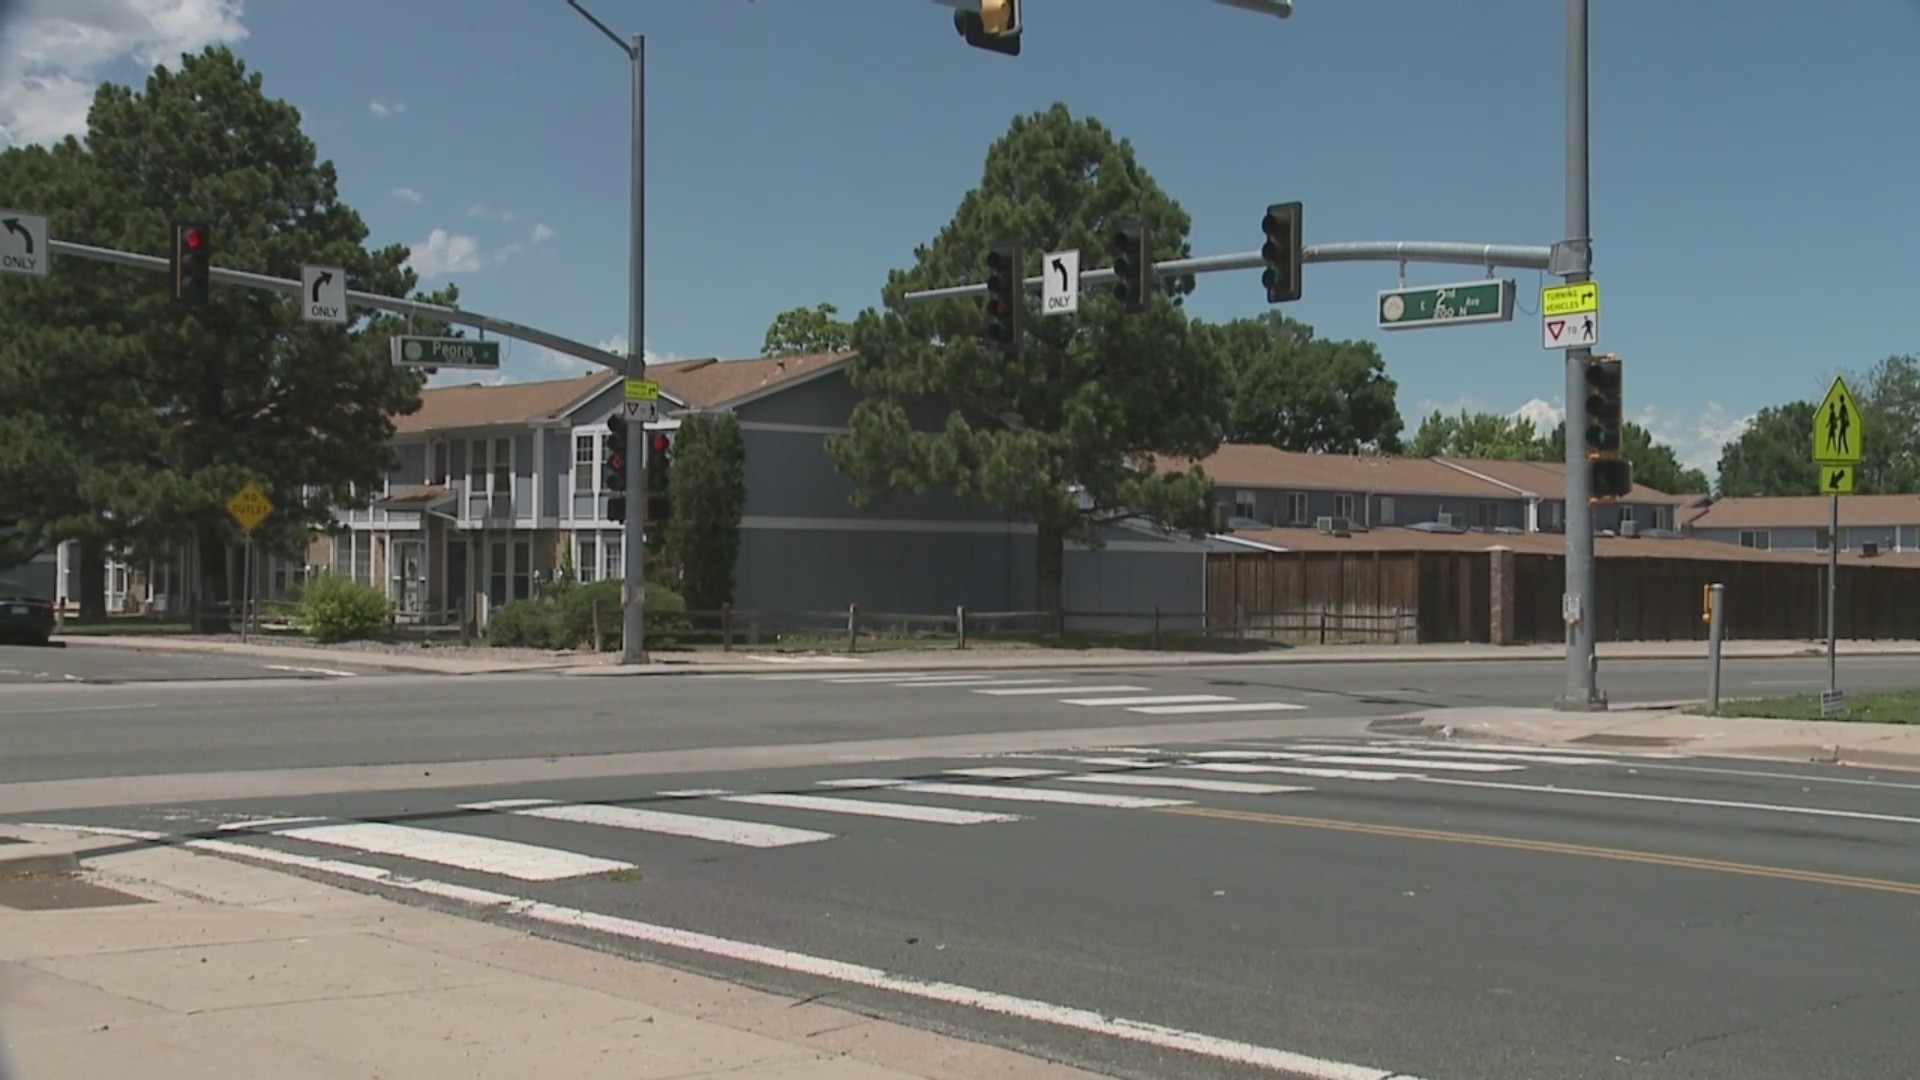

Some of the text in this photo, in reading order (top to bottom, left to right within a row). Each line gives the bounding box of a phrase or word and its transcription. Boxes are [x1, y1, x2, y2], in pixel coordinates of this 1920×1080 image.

[3, 254, 37, 269] ONLY
[1546, 290, 1578, 300] TURNING
[1048, 294, 1072, 309] ONLY
[1465, 297, 1480, 307] Ave
[1546, 301, 1579, 311] VEHICLES
[311, 305, 339, 318] ONLY
[1459, 306, 1468, 317] N
[432, 340, 474, 356] Peoria
[242, 493, 258, 502] NO
[231, 504, 268, 515] OUTLET
